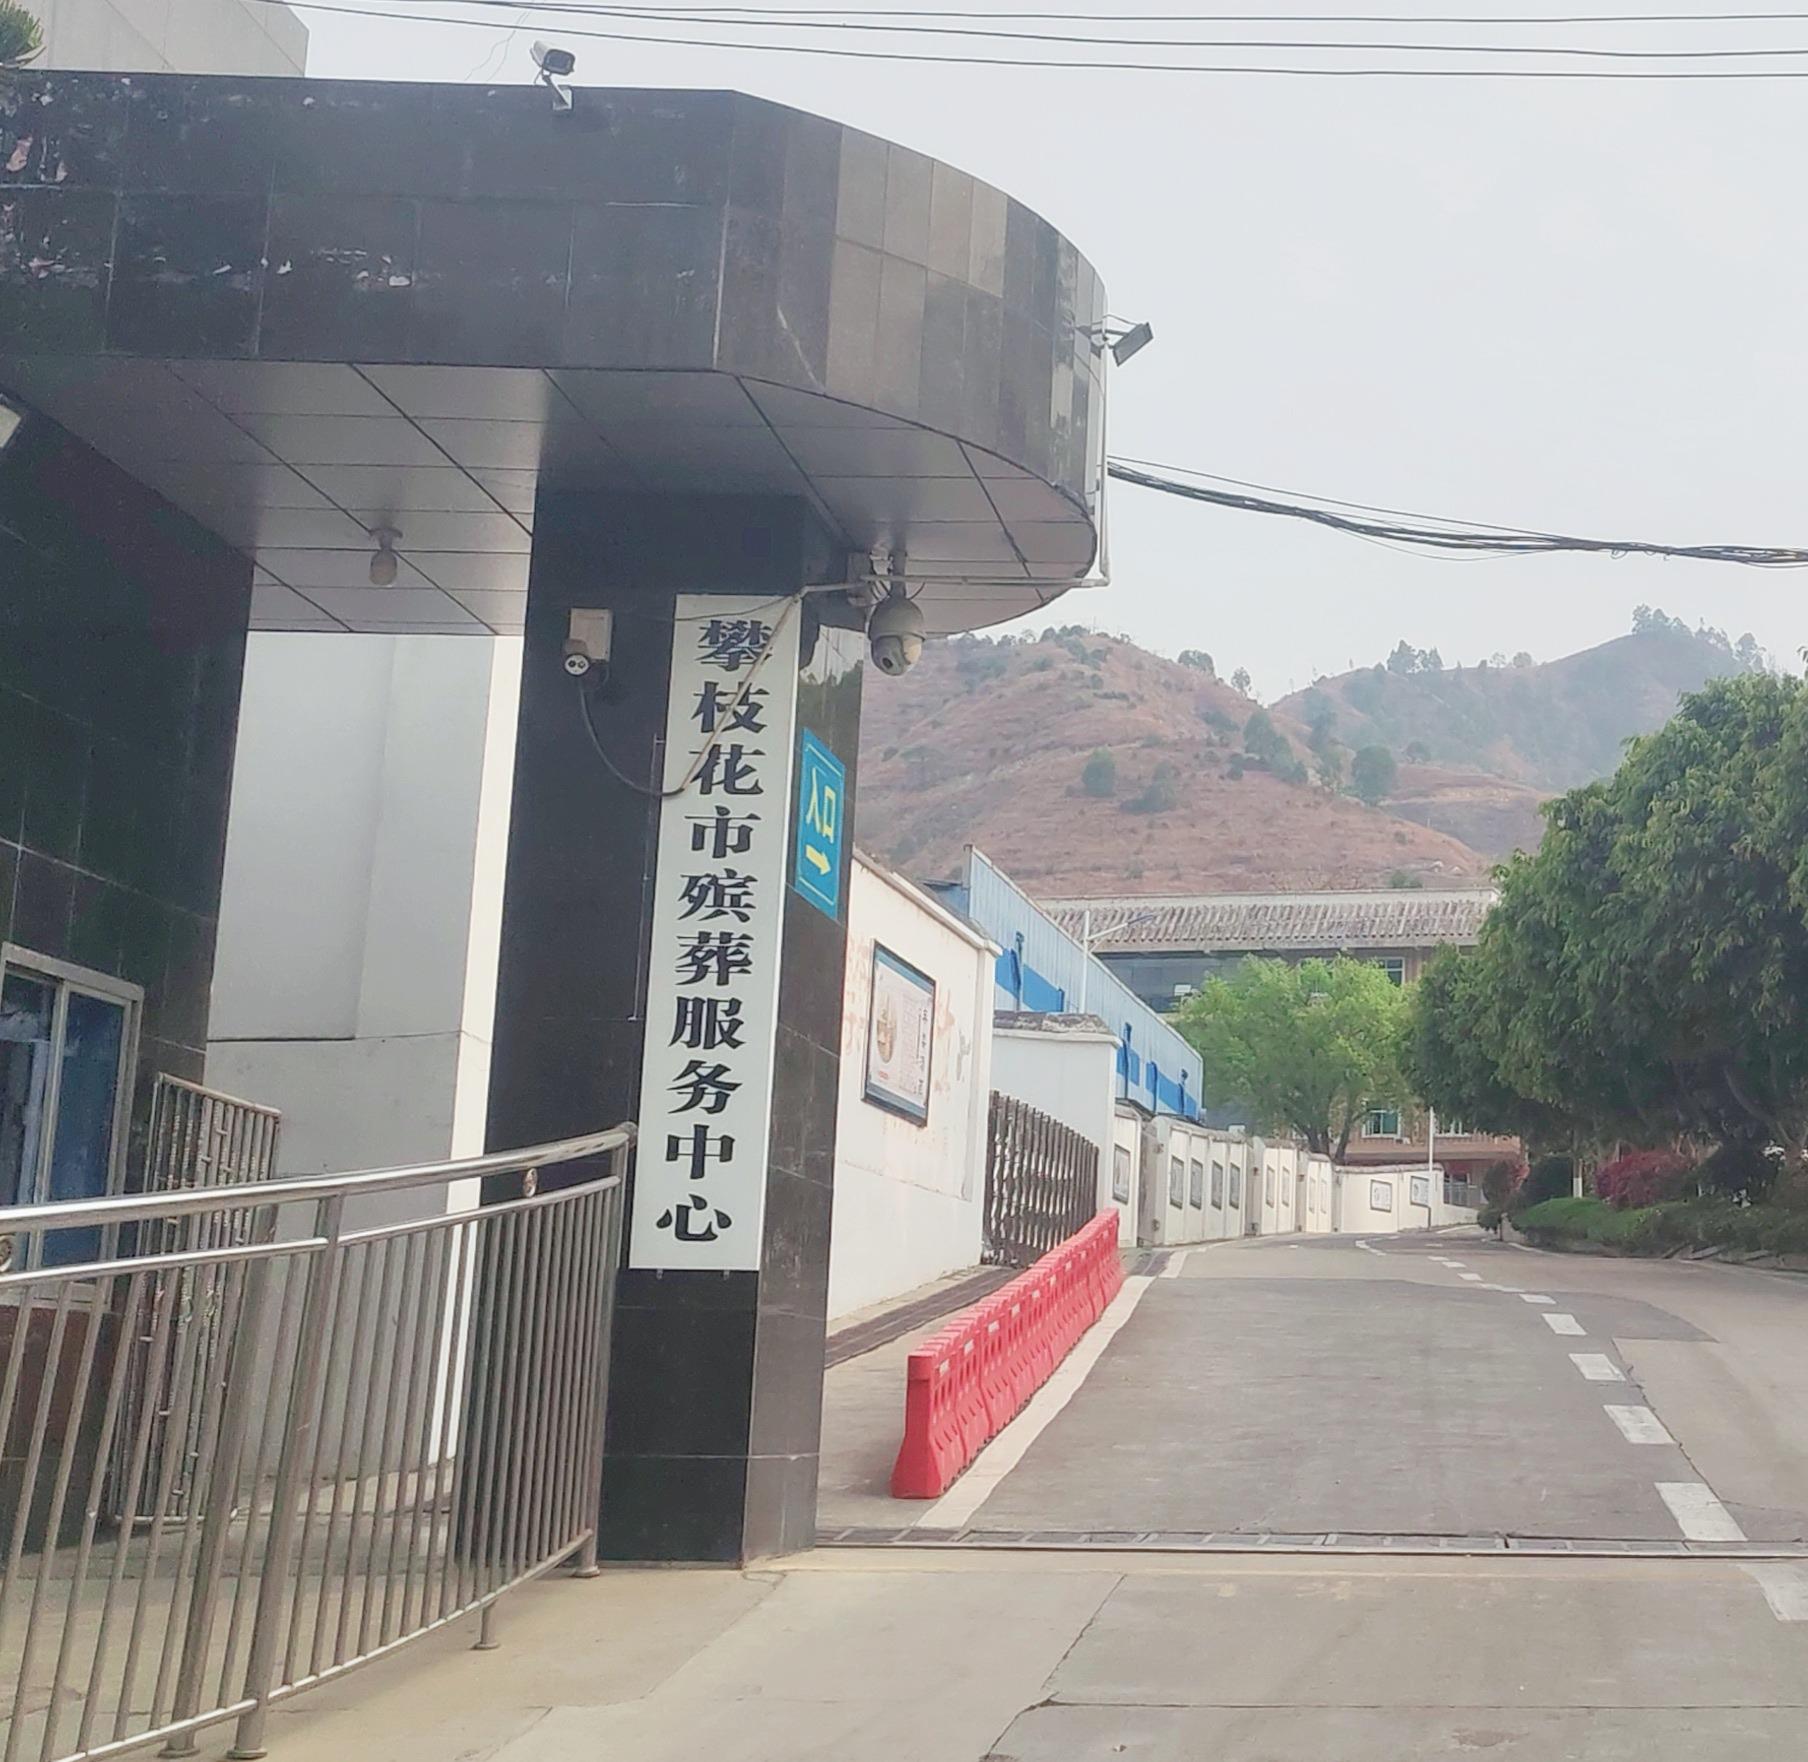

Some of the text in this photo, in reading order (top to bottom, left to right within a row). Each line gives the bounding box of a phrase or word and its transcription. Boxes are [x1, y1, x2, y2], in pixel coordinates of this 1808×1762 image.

[655, 618, 773, 1243] 攀枝花市殡葬服务中心
[806, 767, 836, 844] 入口
